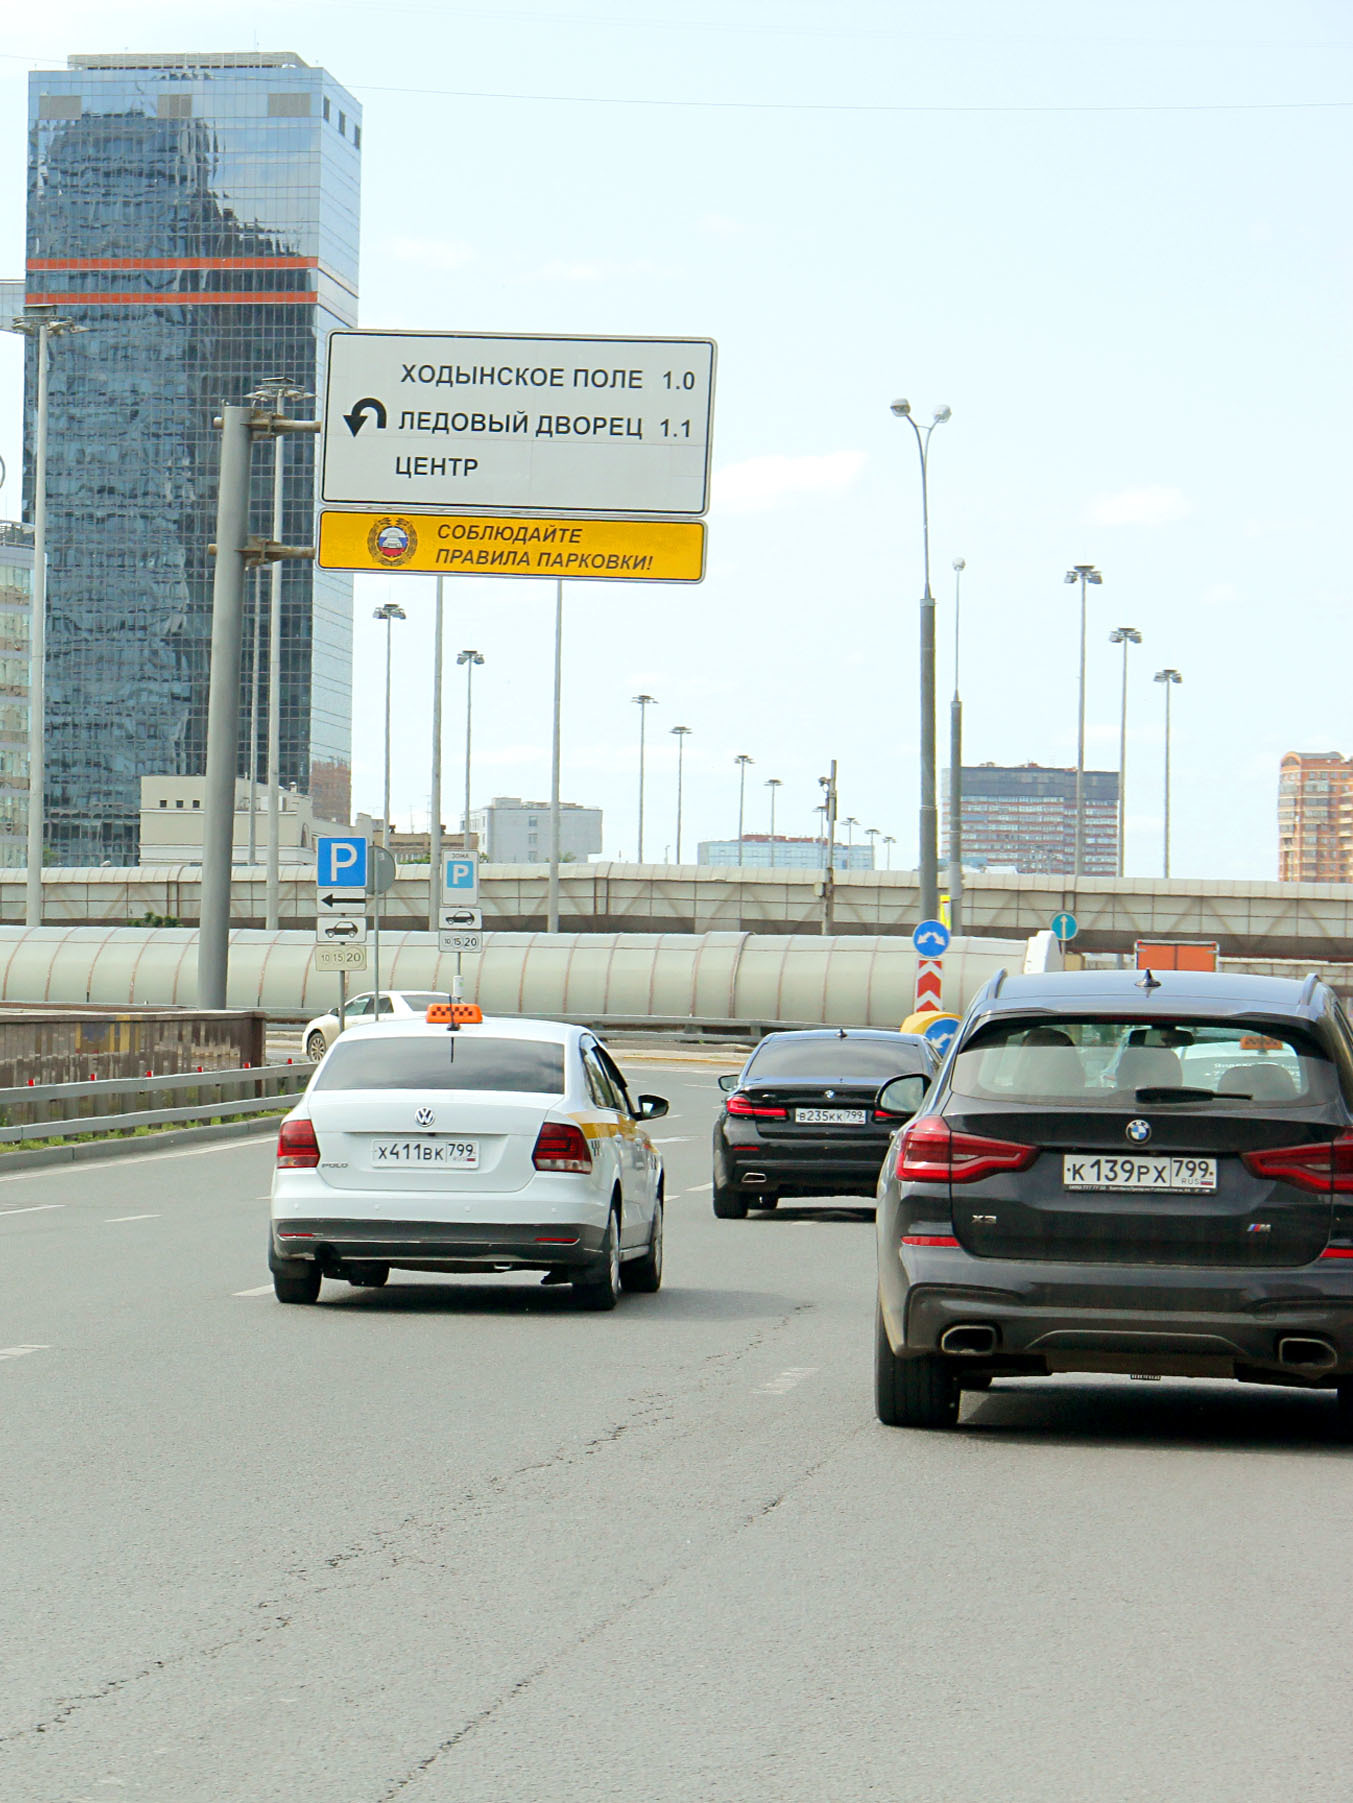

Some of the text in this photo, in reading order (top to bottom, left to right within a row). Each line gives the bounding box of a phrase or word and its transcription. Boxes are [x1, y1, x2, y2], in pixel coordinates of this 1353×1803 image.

[400, 364, 696, 390] ХОДЫНСКОЕ ПОЛЕ 1.0
[398, 410, 691, 440] ЛЕДОВЫЙ ДВОРЕЦ 1.1
[395, 456, 479, 479] ЦЕНТР
[437, 524, 583, 545] СОБЛЮДАЙТЕ
[435, 548, 654, 571] ПРАВИЛА ПАРКОВКИ!
[330, 843, 358, 882] P
[452, 864, 469, 885] P
[464, 937, 477, 947] 20
[346, 952, 361, 962] 20
[448, 1143, 474, 1157] 799
[1173, 1159, 1209, 1178] 799
